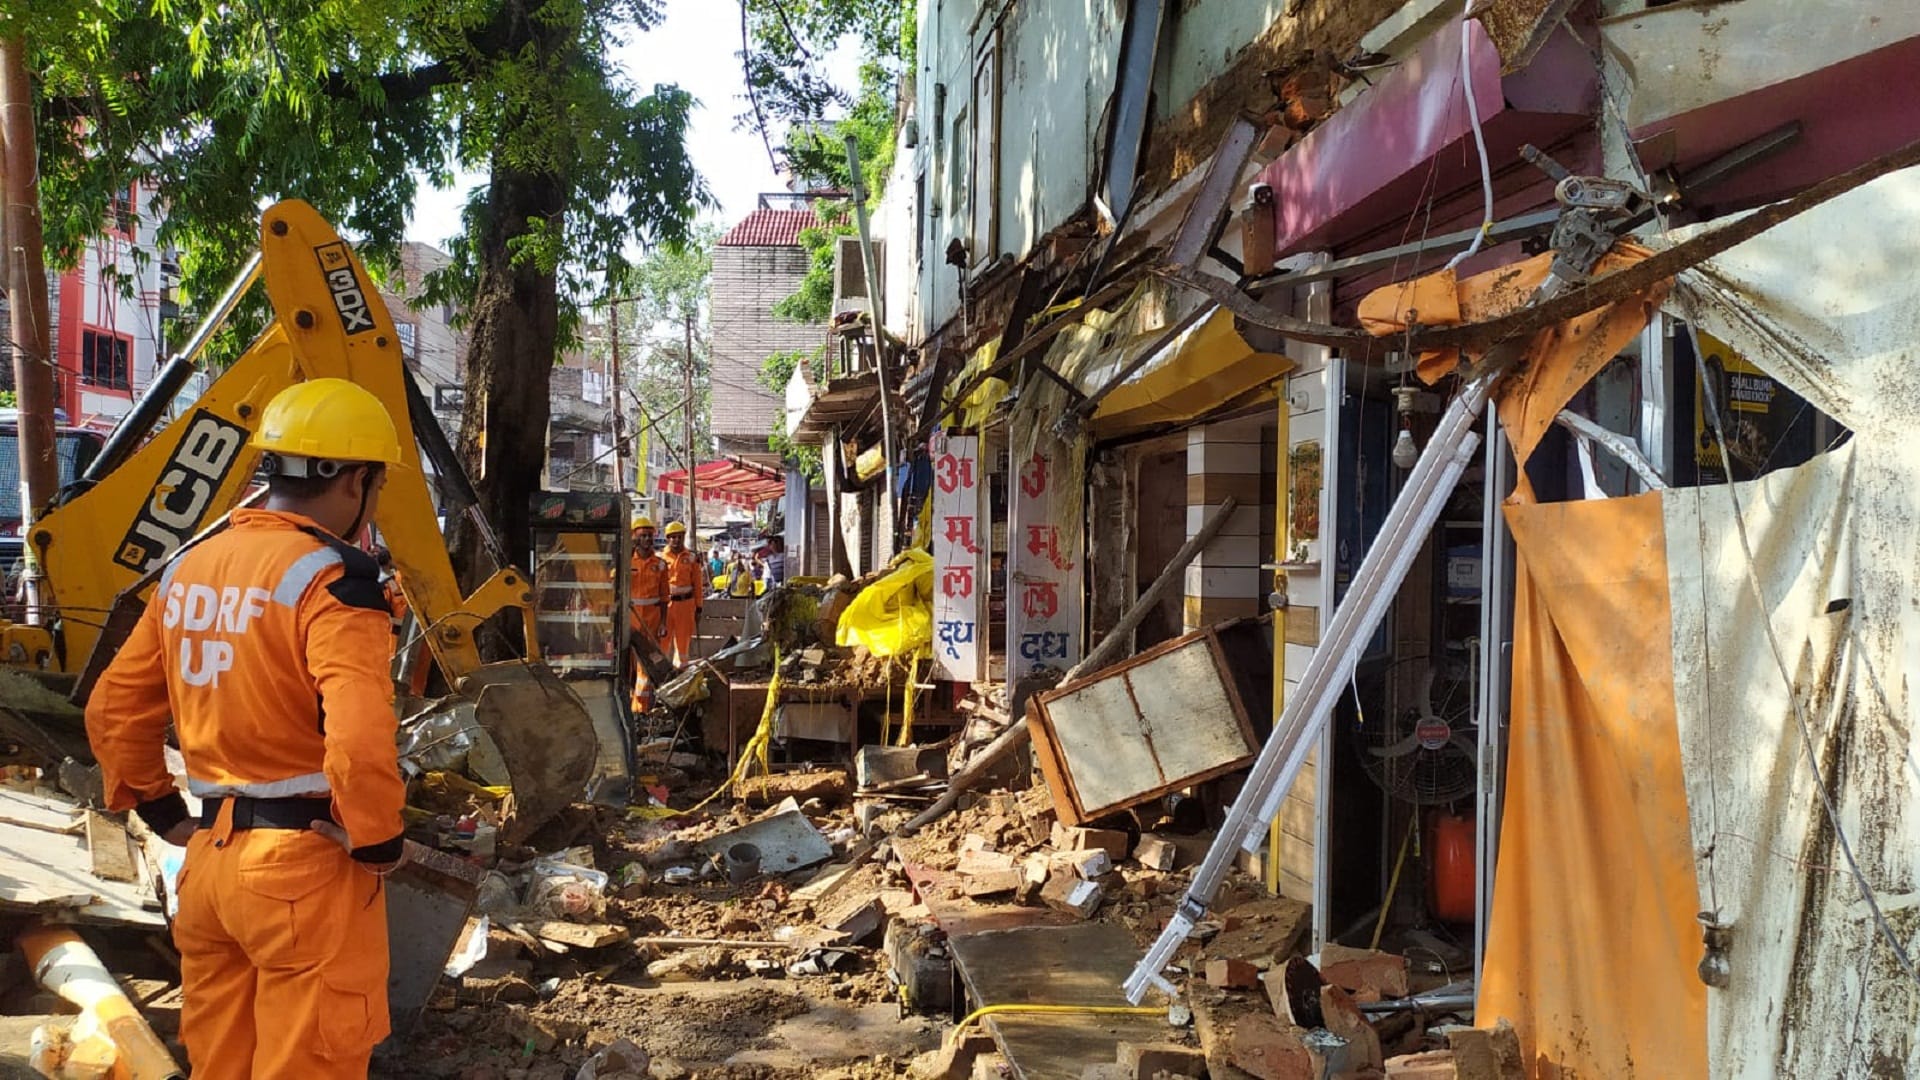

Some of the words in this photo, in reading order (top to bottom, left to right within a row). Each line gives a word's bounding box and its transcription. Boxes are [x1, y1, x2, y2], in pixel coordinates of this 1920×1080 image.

[329, 269, 373, 331] 3DX
[136, 418, 240, 573] JCB
[163, 582, 271, 634] SDRF
[180, 637, 234, 689] UP
